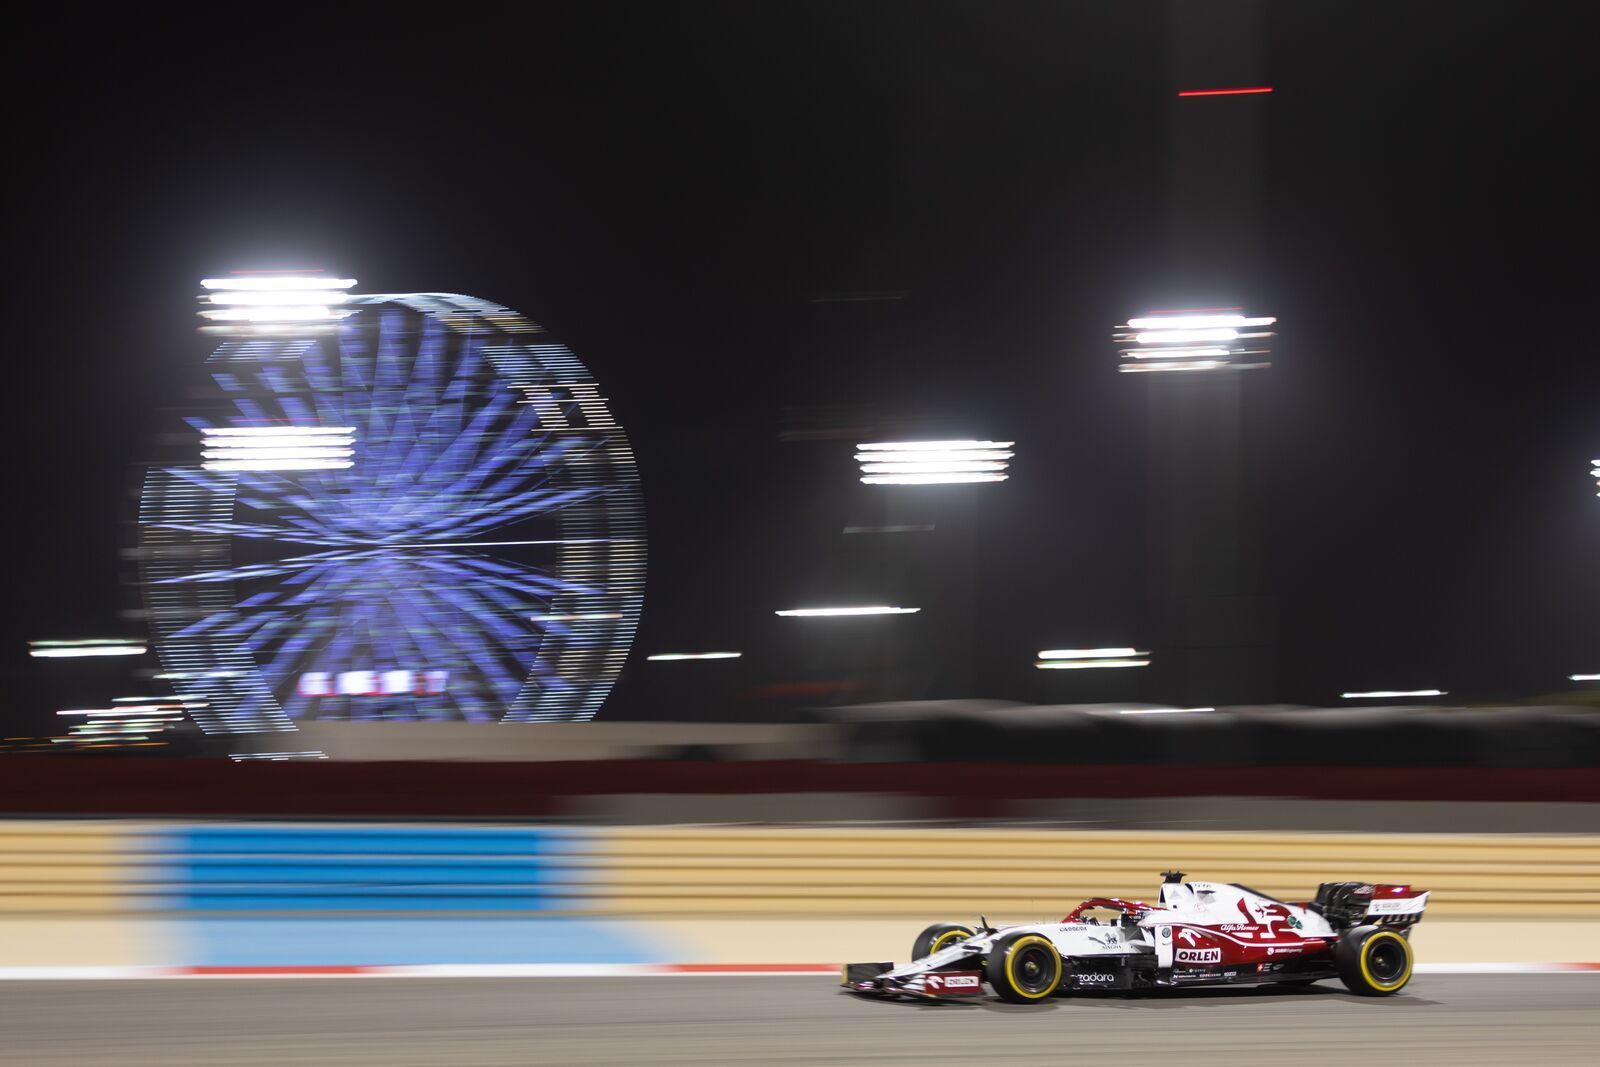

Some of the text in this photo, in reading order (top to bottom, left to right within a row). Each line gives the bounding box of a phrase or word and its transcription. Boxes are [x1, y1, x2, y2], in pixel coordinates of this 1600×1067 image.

[1220, 923, 1260, 932] Alfa Romeo
[1178, 950, 1219, 961] ORLEN
[1077, 972, 1115, 982] zadara
